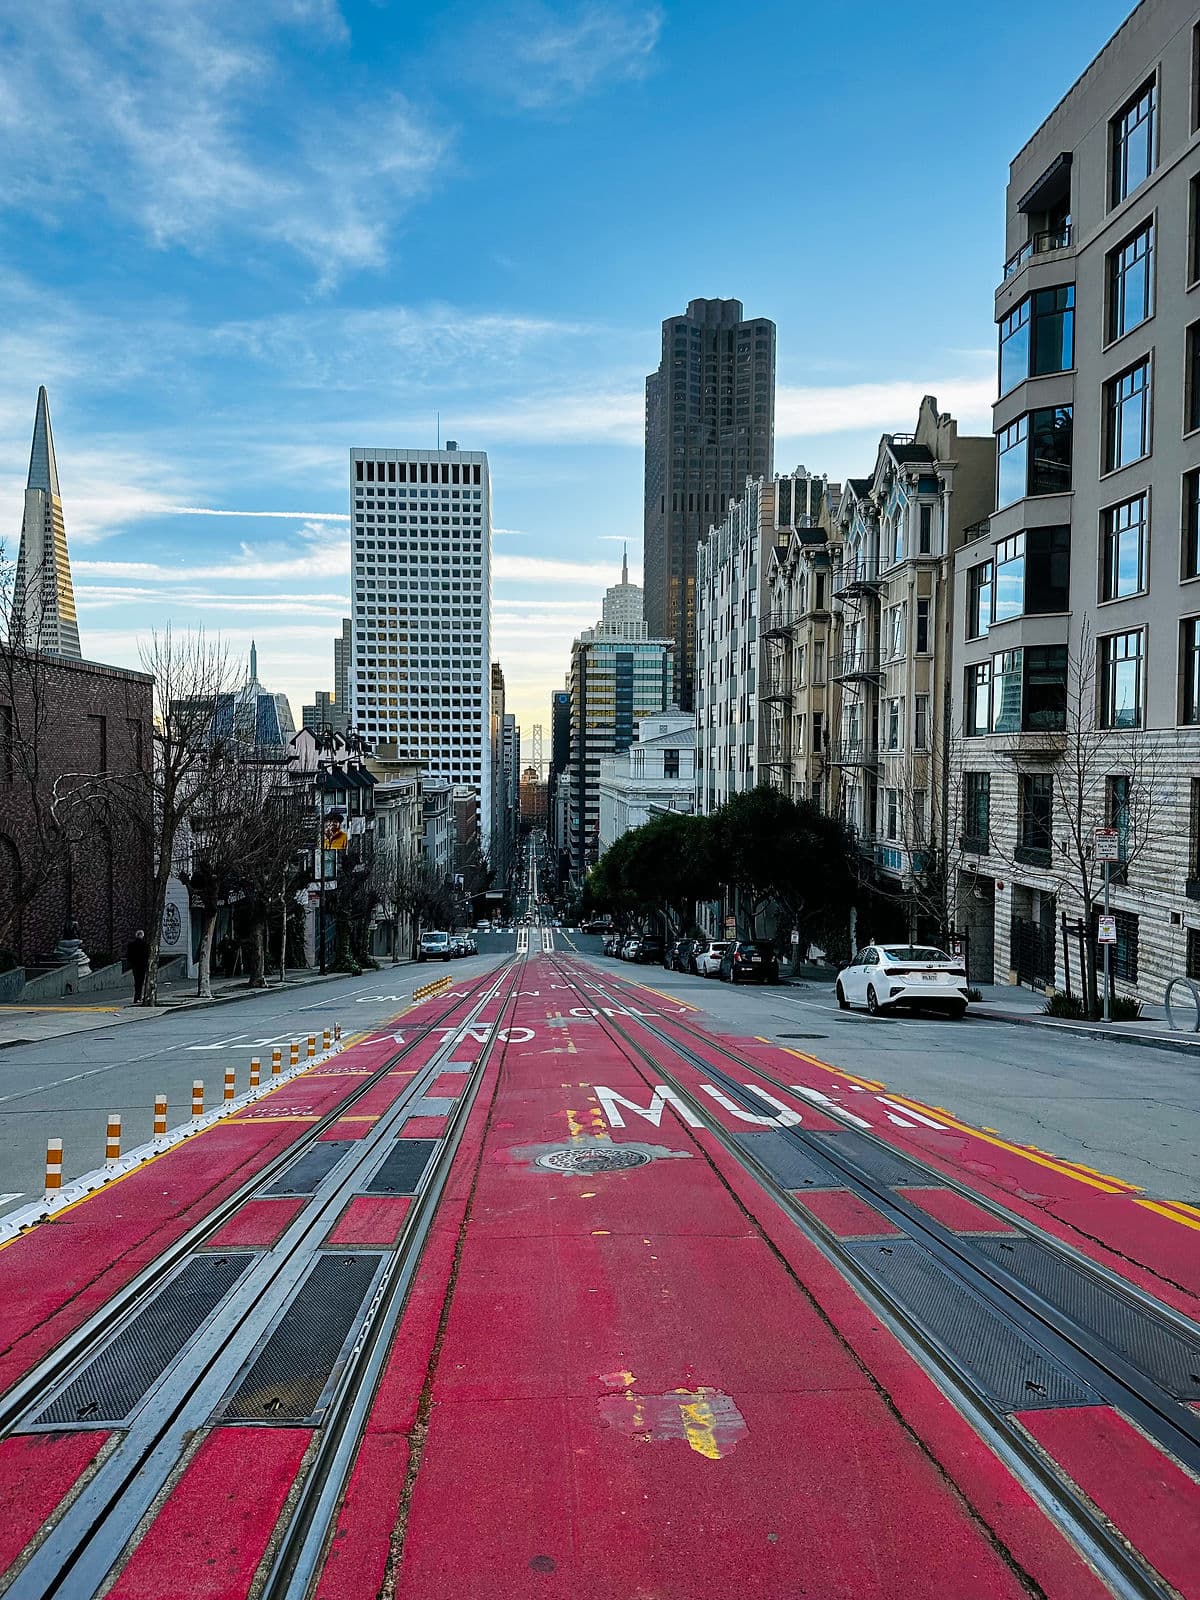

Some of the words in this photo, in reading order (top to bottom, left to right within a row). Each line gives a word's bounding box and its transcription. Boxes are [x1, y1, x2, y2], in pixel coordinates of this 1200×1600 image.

[568, 1007, 687, 1017] ONLY
[359, 1027, 536, 1045] ONLY
[593, 1085, 951, 1129] MUNI
